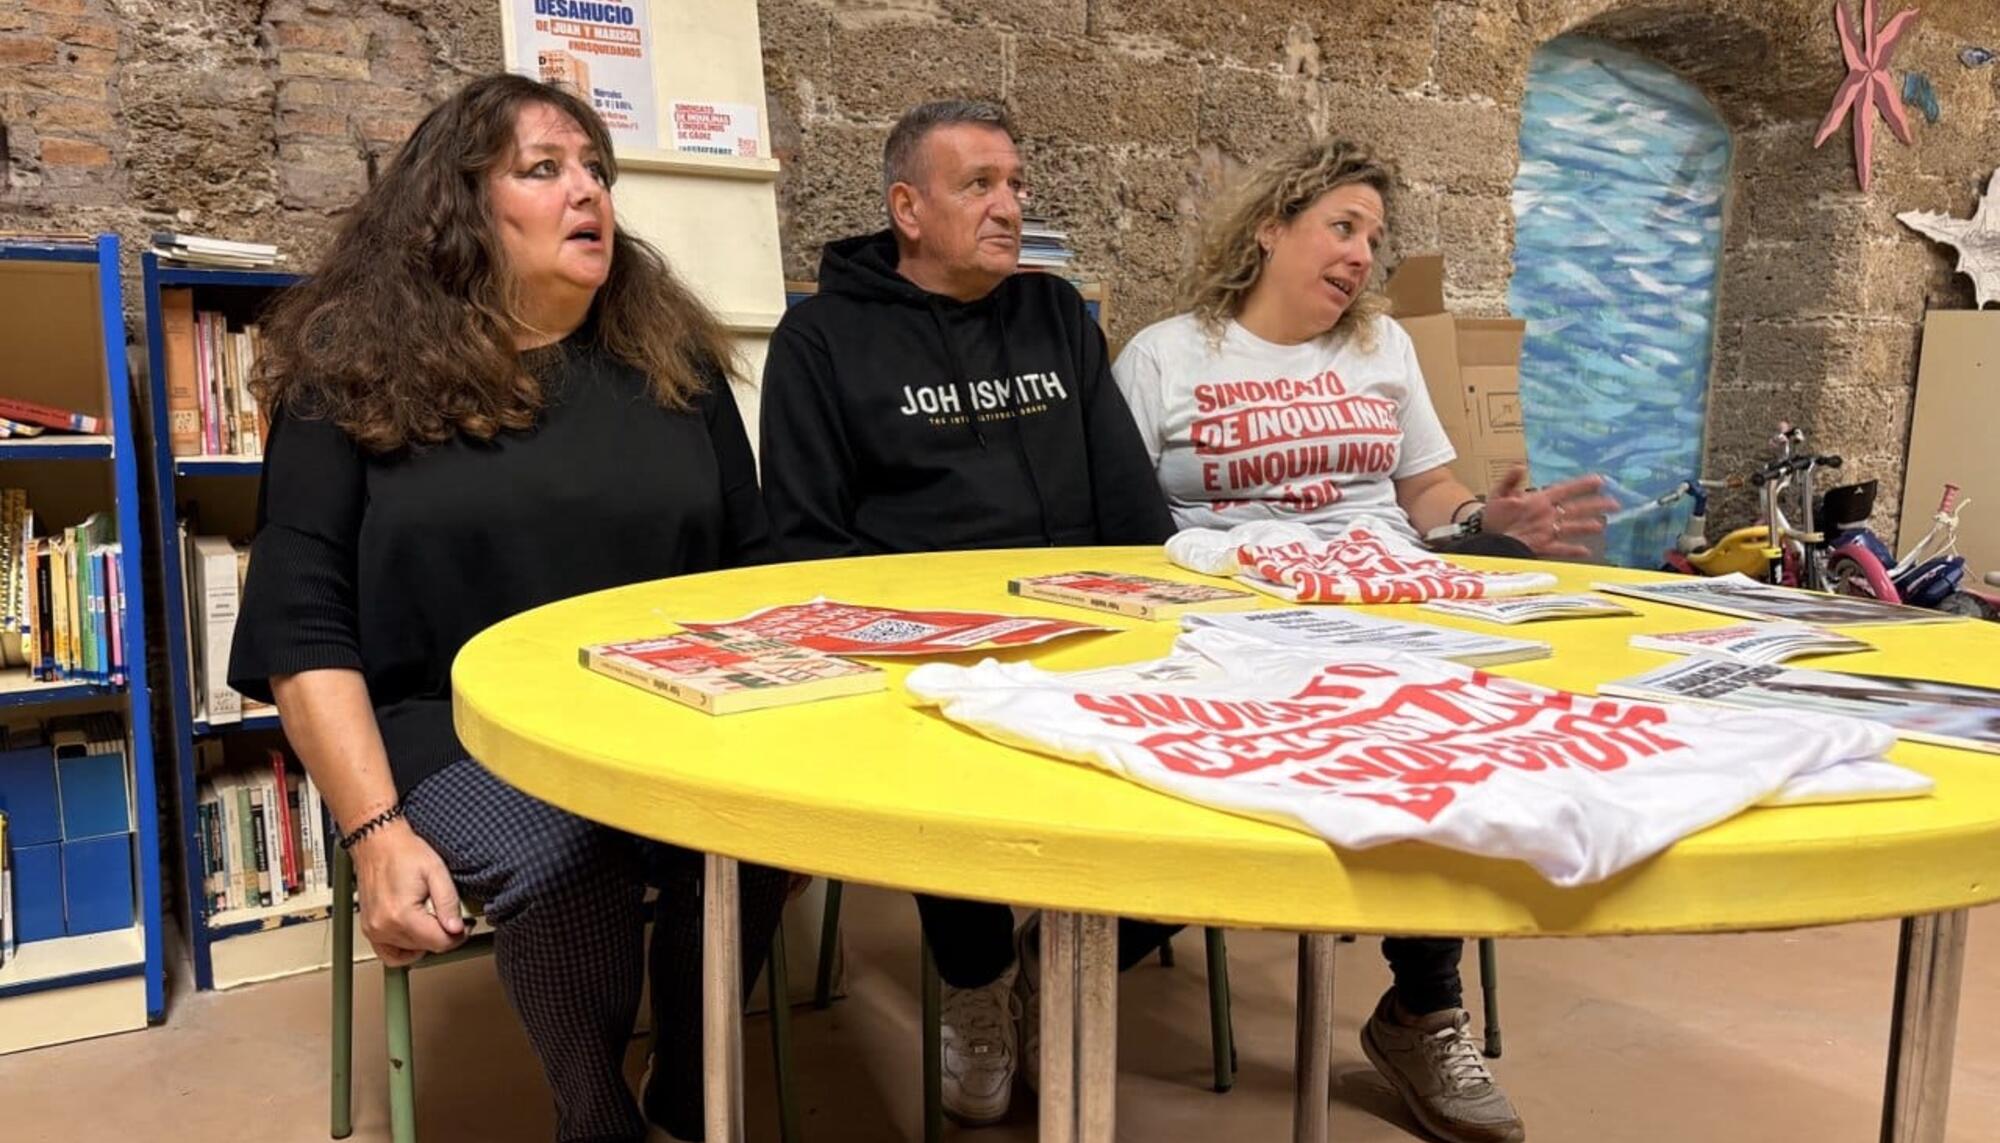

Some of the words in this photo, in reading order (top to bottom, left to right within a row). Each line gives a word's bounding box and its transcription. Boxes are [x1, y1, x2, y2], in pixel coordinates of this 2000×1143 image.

[534, 0, 634, 25] DESAHUCIO
[535, 19, 549, 32] DE
[552, 21, 580, 36] JUAN
[594, 27, 639, 43] MARISOL
[1194, 370, 1346, 413] SINDICATO
[1200, 418, 1242, 449] DE
[1203, 463, 1222, 491] E
[1229, 442, 1395, 489] INQUILINOS
